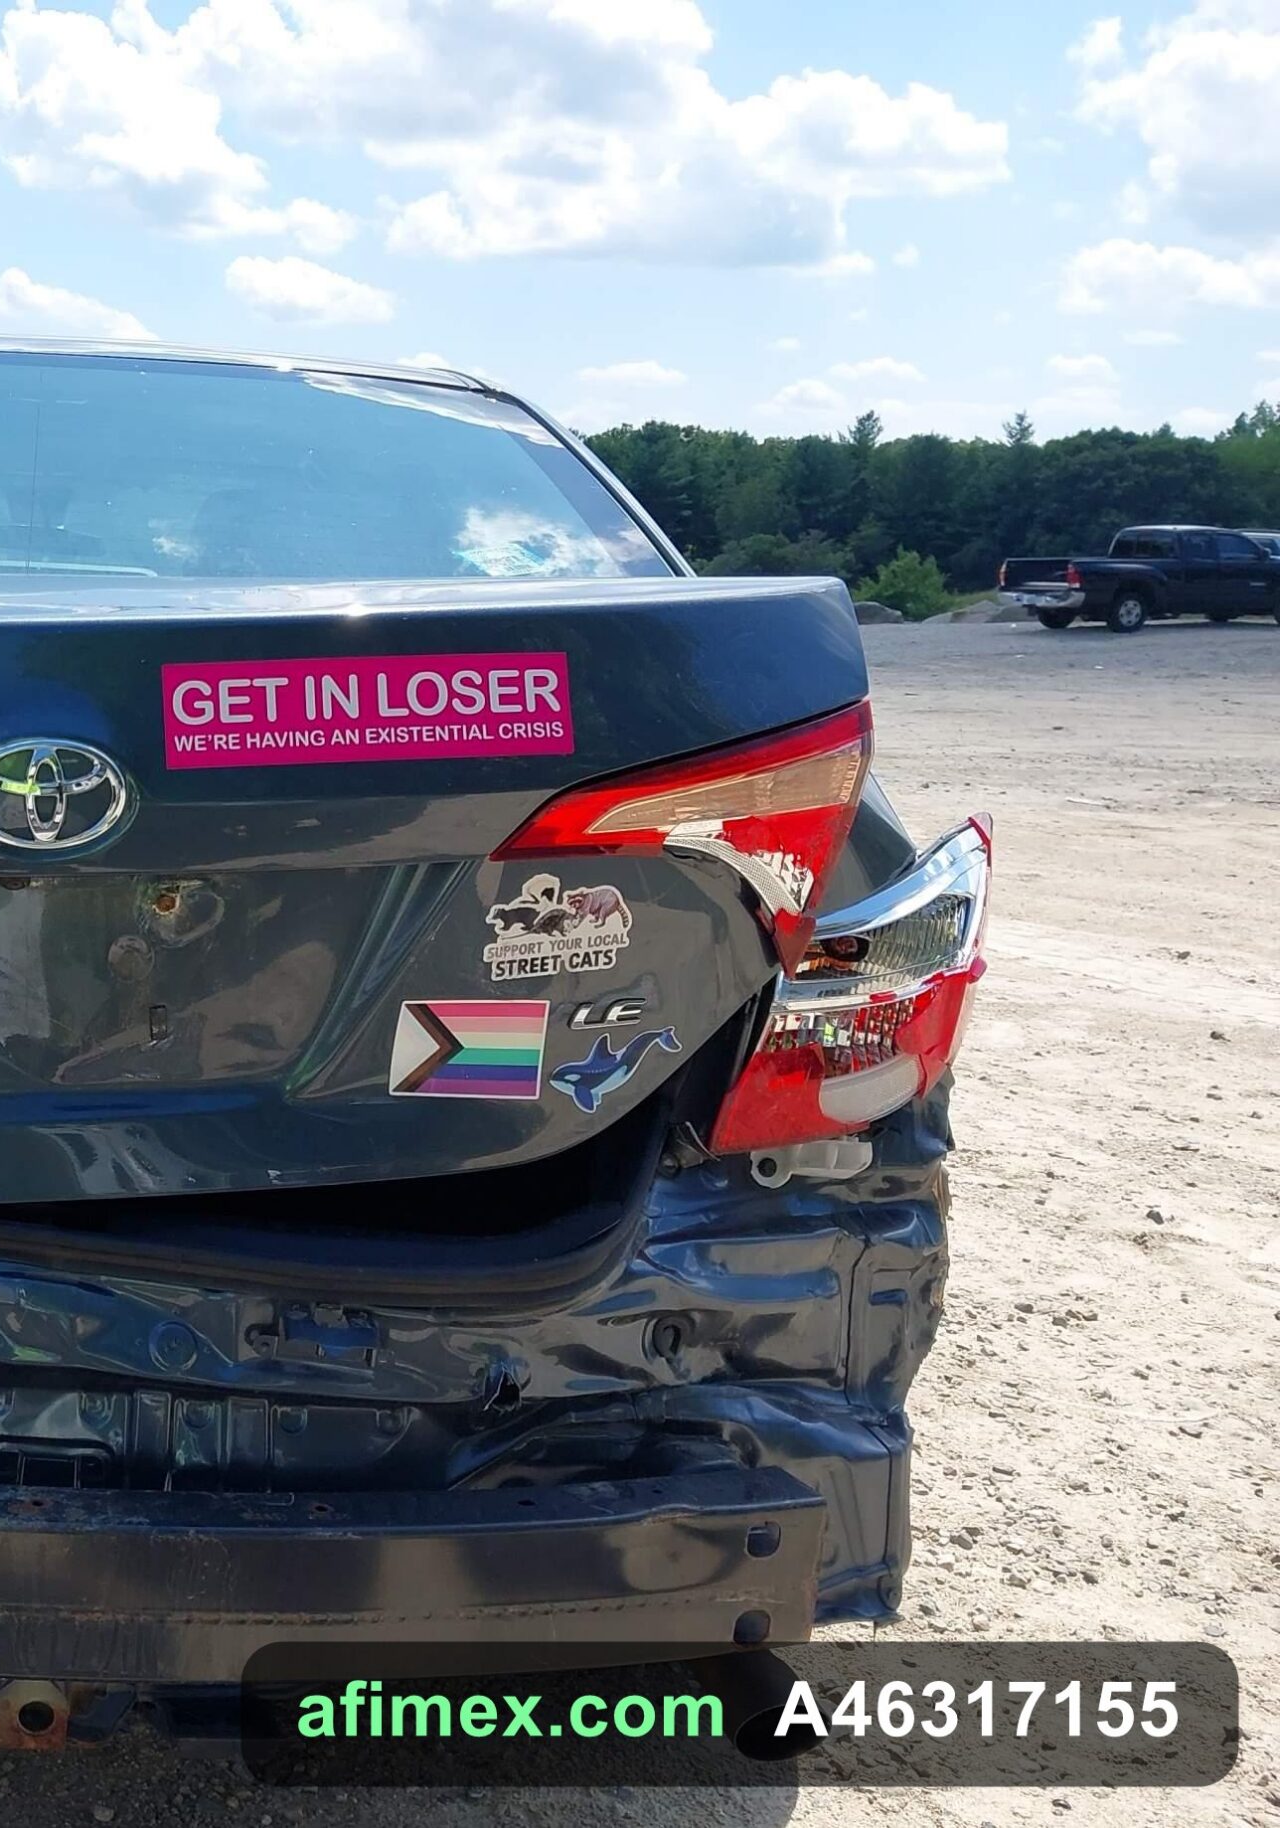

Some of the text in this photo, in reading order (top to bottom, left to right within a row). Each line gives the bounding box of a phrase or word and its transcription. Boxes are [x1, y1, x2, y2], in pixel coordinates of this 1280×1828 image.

[172, 668, 561, 726] GET IN LOSER
[246, 730, 326, 750] HAVING
[331, 728, 360, 746] AN
[365, 724, 495, 745] EXISTENTIAL
[498, 721, 564, 740] CRISIS
[486, 932, 627, 960] SUPPORT YOUR LOCAL
[495, 948, 614, 978] STREET CATS
[567, 997, 648, 1030] LE
